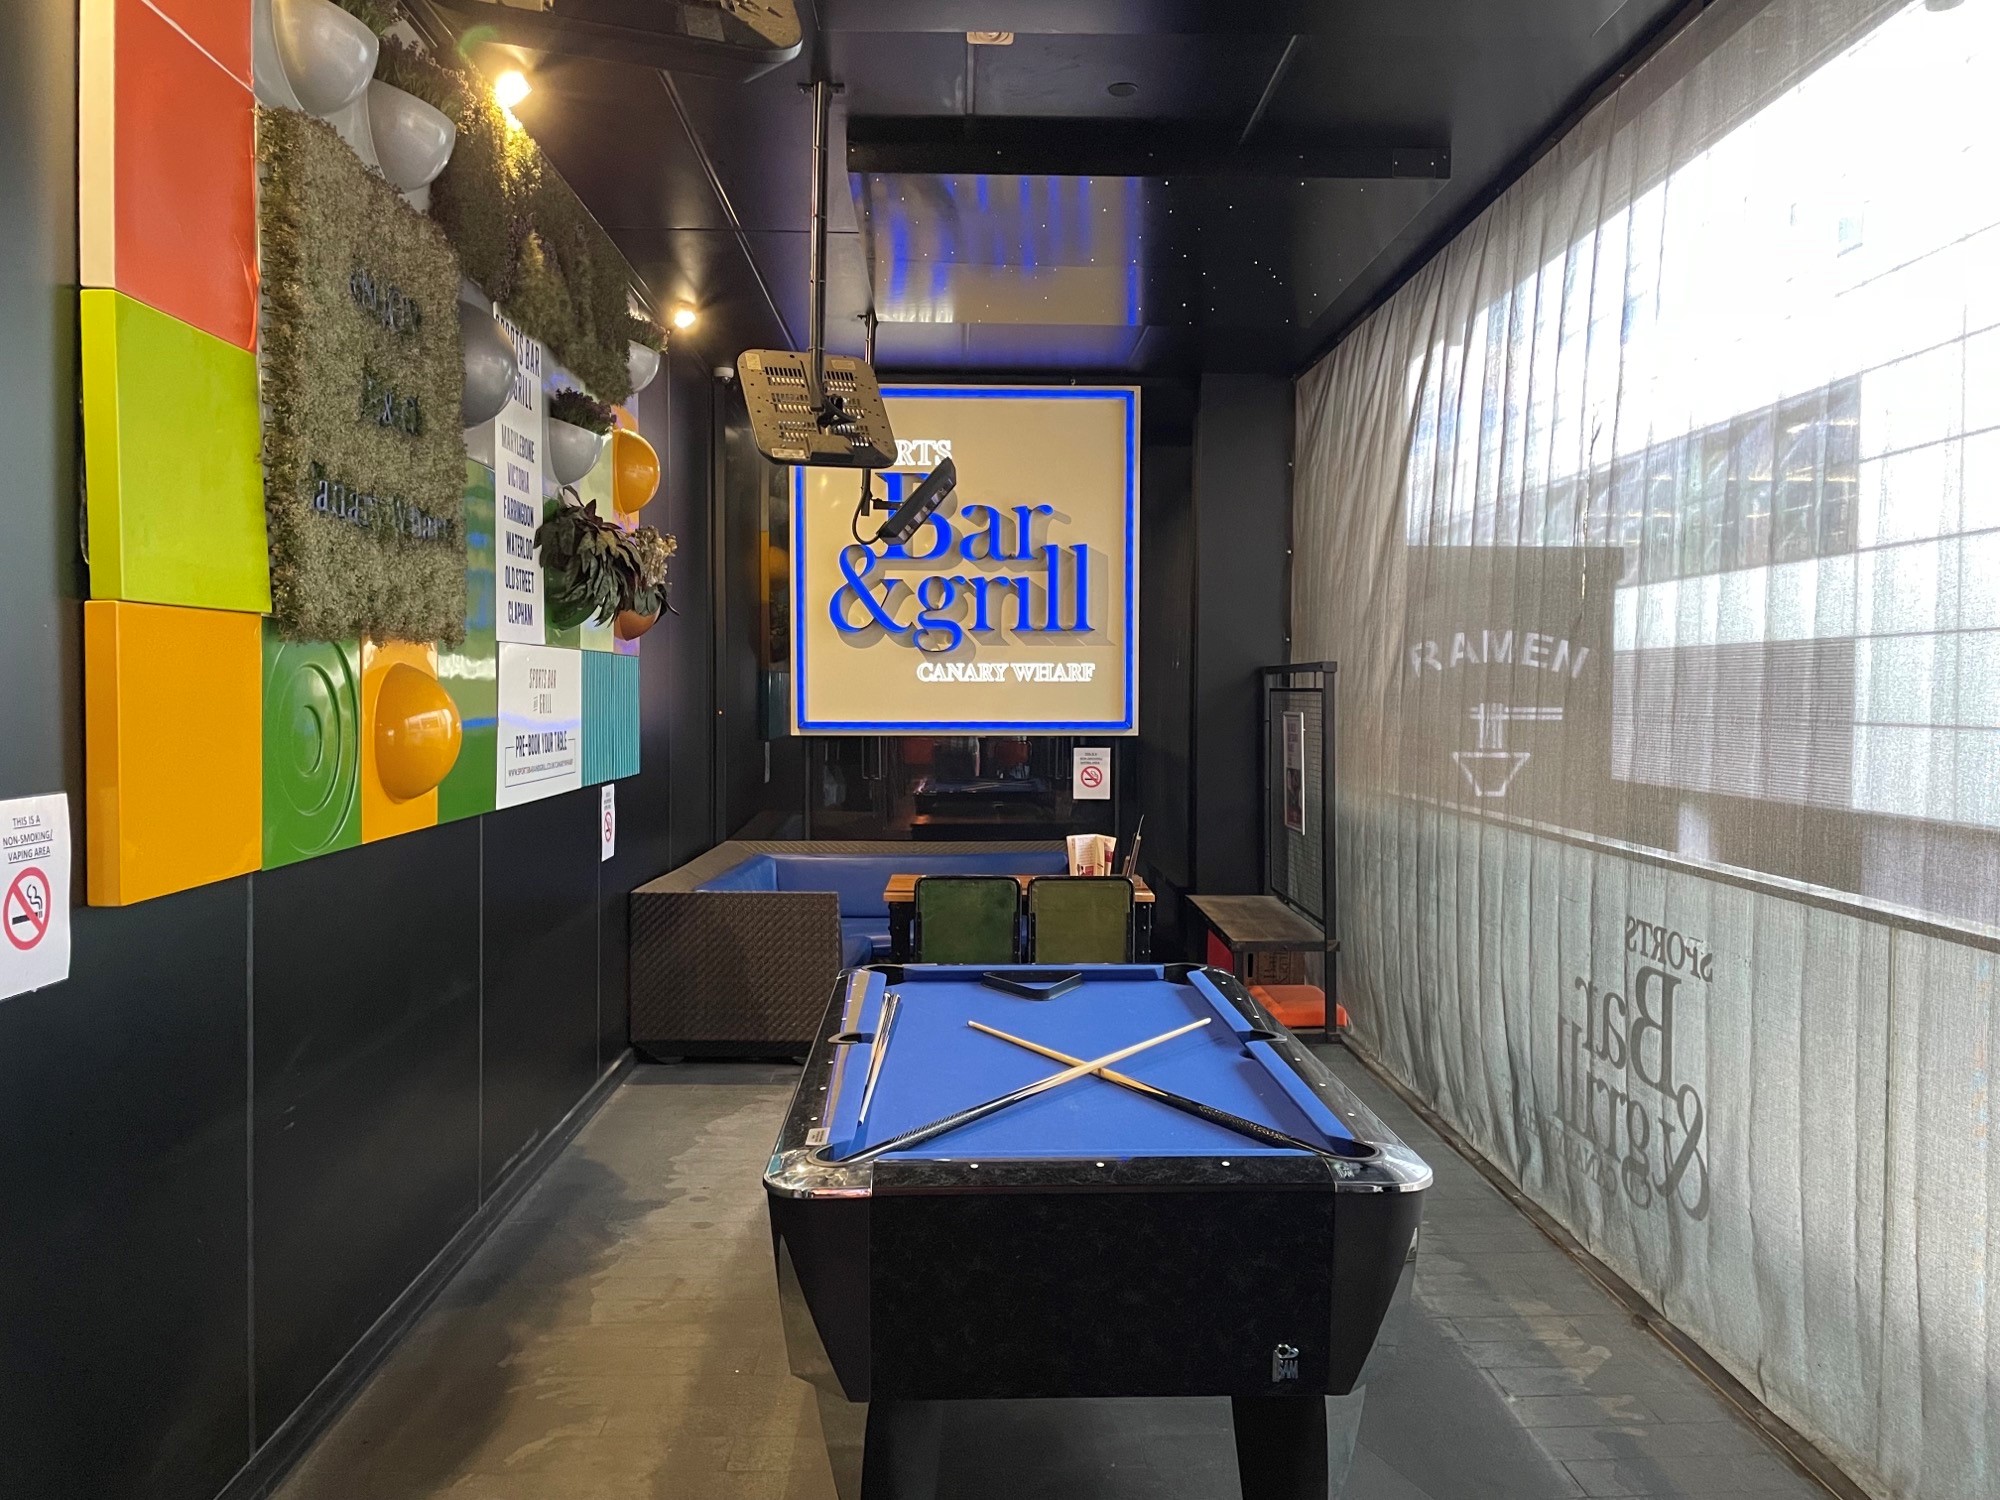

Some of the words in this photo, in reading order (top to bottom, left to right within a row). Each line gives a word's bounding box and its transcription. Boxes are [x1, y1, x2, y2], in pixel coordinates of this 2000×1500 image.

[526, 339, 540, 377] BAR
[501, 424, 534, 464] MARYLEBONE
[895, 439, 952, 466] RTS
[507, 462, 529, 494] VICTORIA
[504, 495, 535, 529] FARRINGDON
[875, 472, 1053, 561] Bar
[506, 531, 533, 560] WATERLOO
[505, 565, 516, 590] OLD
[516, 568, 534, 593] STREET
[508, 601, 534, 626] CLAPHAM
[1410, 629, 1590, 679] RAMEN
[529, 668, 547, 689] SPORTS
[547, 669, 557, 689] BAR
[916, 662, 1009, 682] CANARY
[1011, 662, 1096, 682] WHARF
[539, 693, 552, 714] GRILL
[515, 734, 540, 758] PRE-BOOK
[541, 732, 553, 754] YOUR
[554, 730, 567, 752] TABLE
[12, 816, 28, 827] THIS
[28, 815, 35, 825] IS
[8, 848, 33, 862] VAPING
[34, 845, 51, 858] AREA
